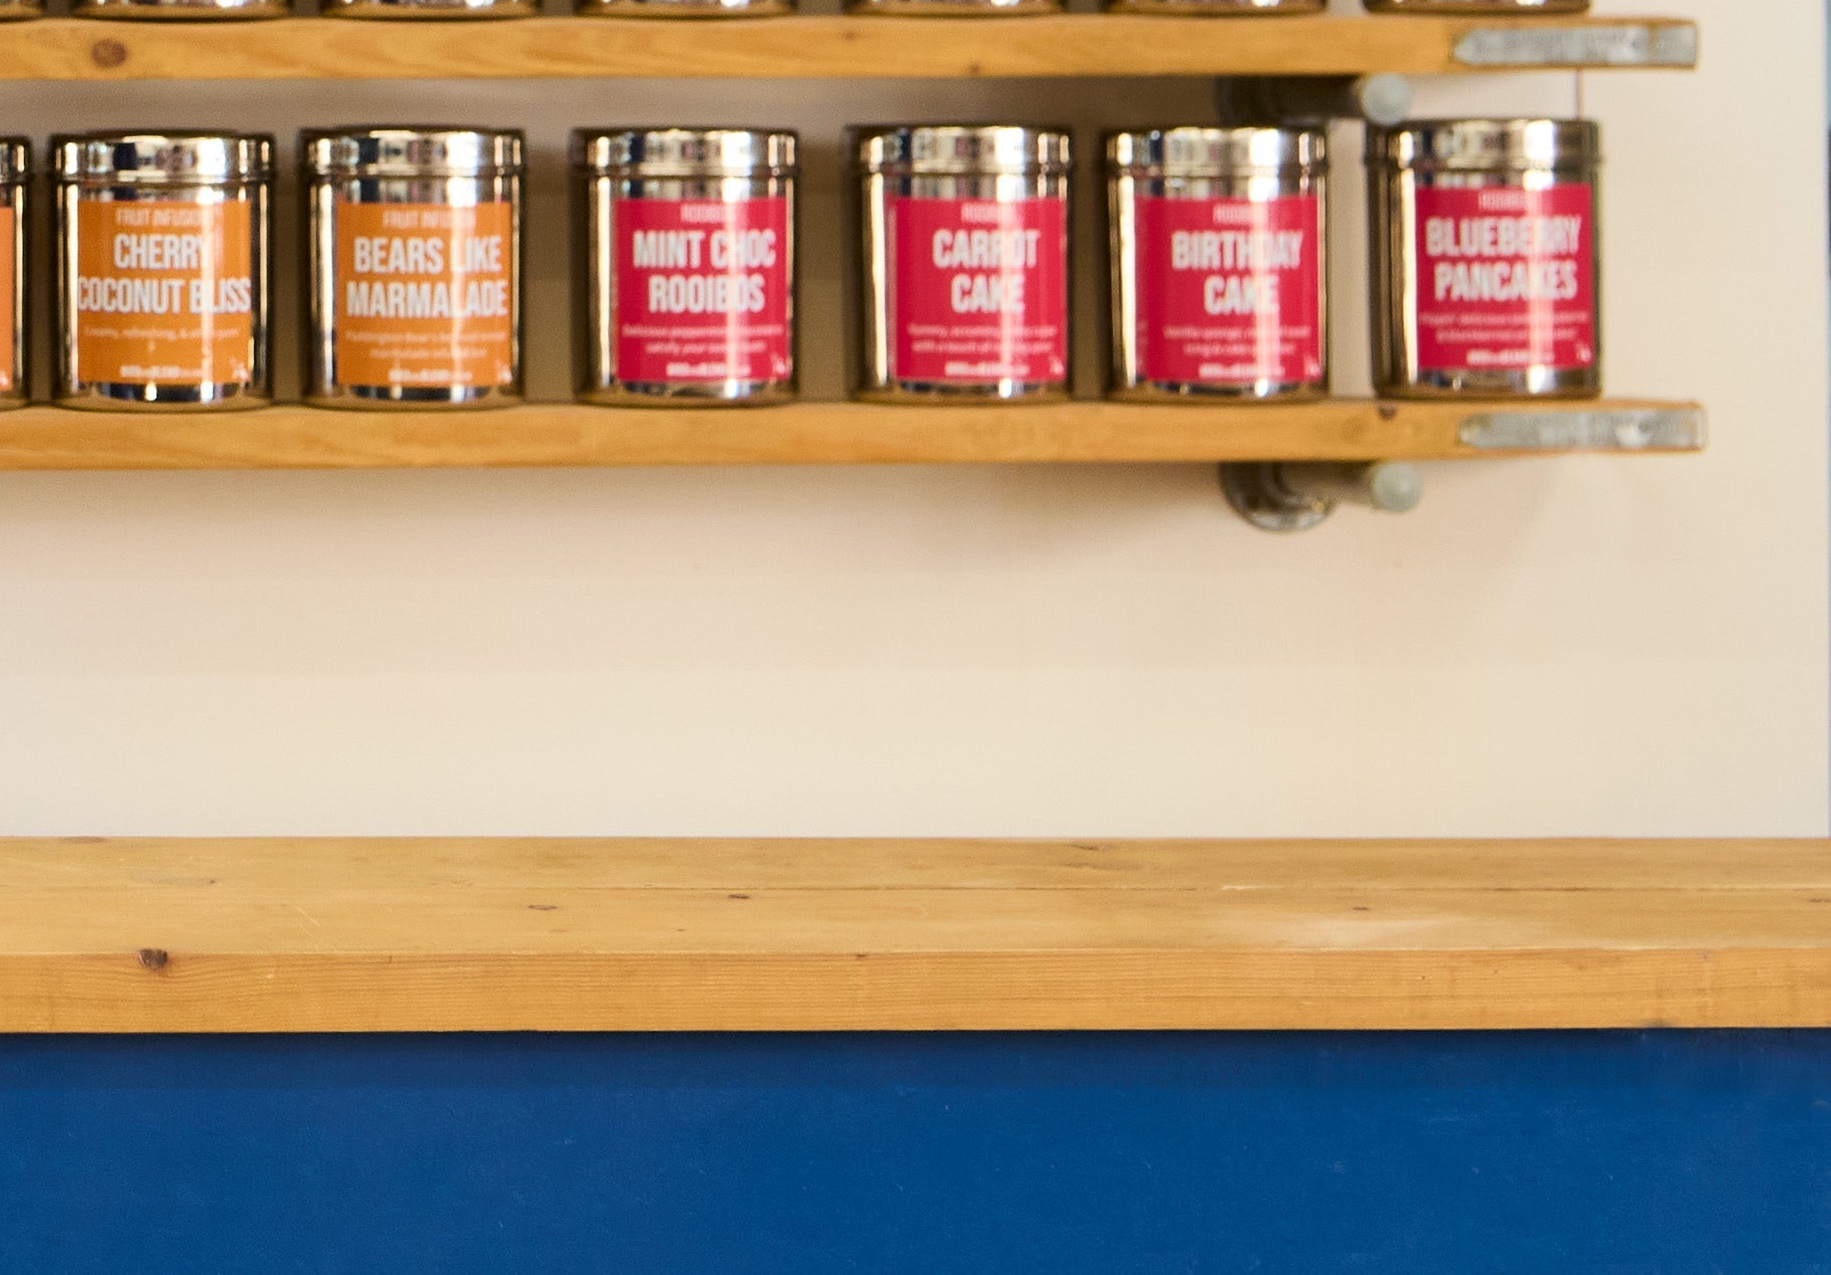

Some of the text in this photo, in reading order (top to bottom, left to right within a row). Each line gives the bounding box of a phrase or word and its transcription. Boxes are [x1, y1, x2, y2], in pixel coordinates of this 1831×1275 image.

[114, 234, 206, 271] CHERRY
[354, 237, 442, 272] BEARS
[634, 230, 703, 268] MINT
[77, 276, 186, 314] COCONUT
